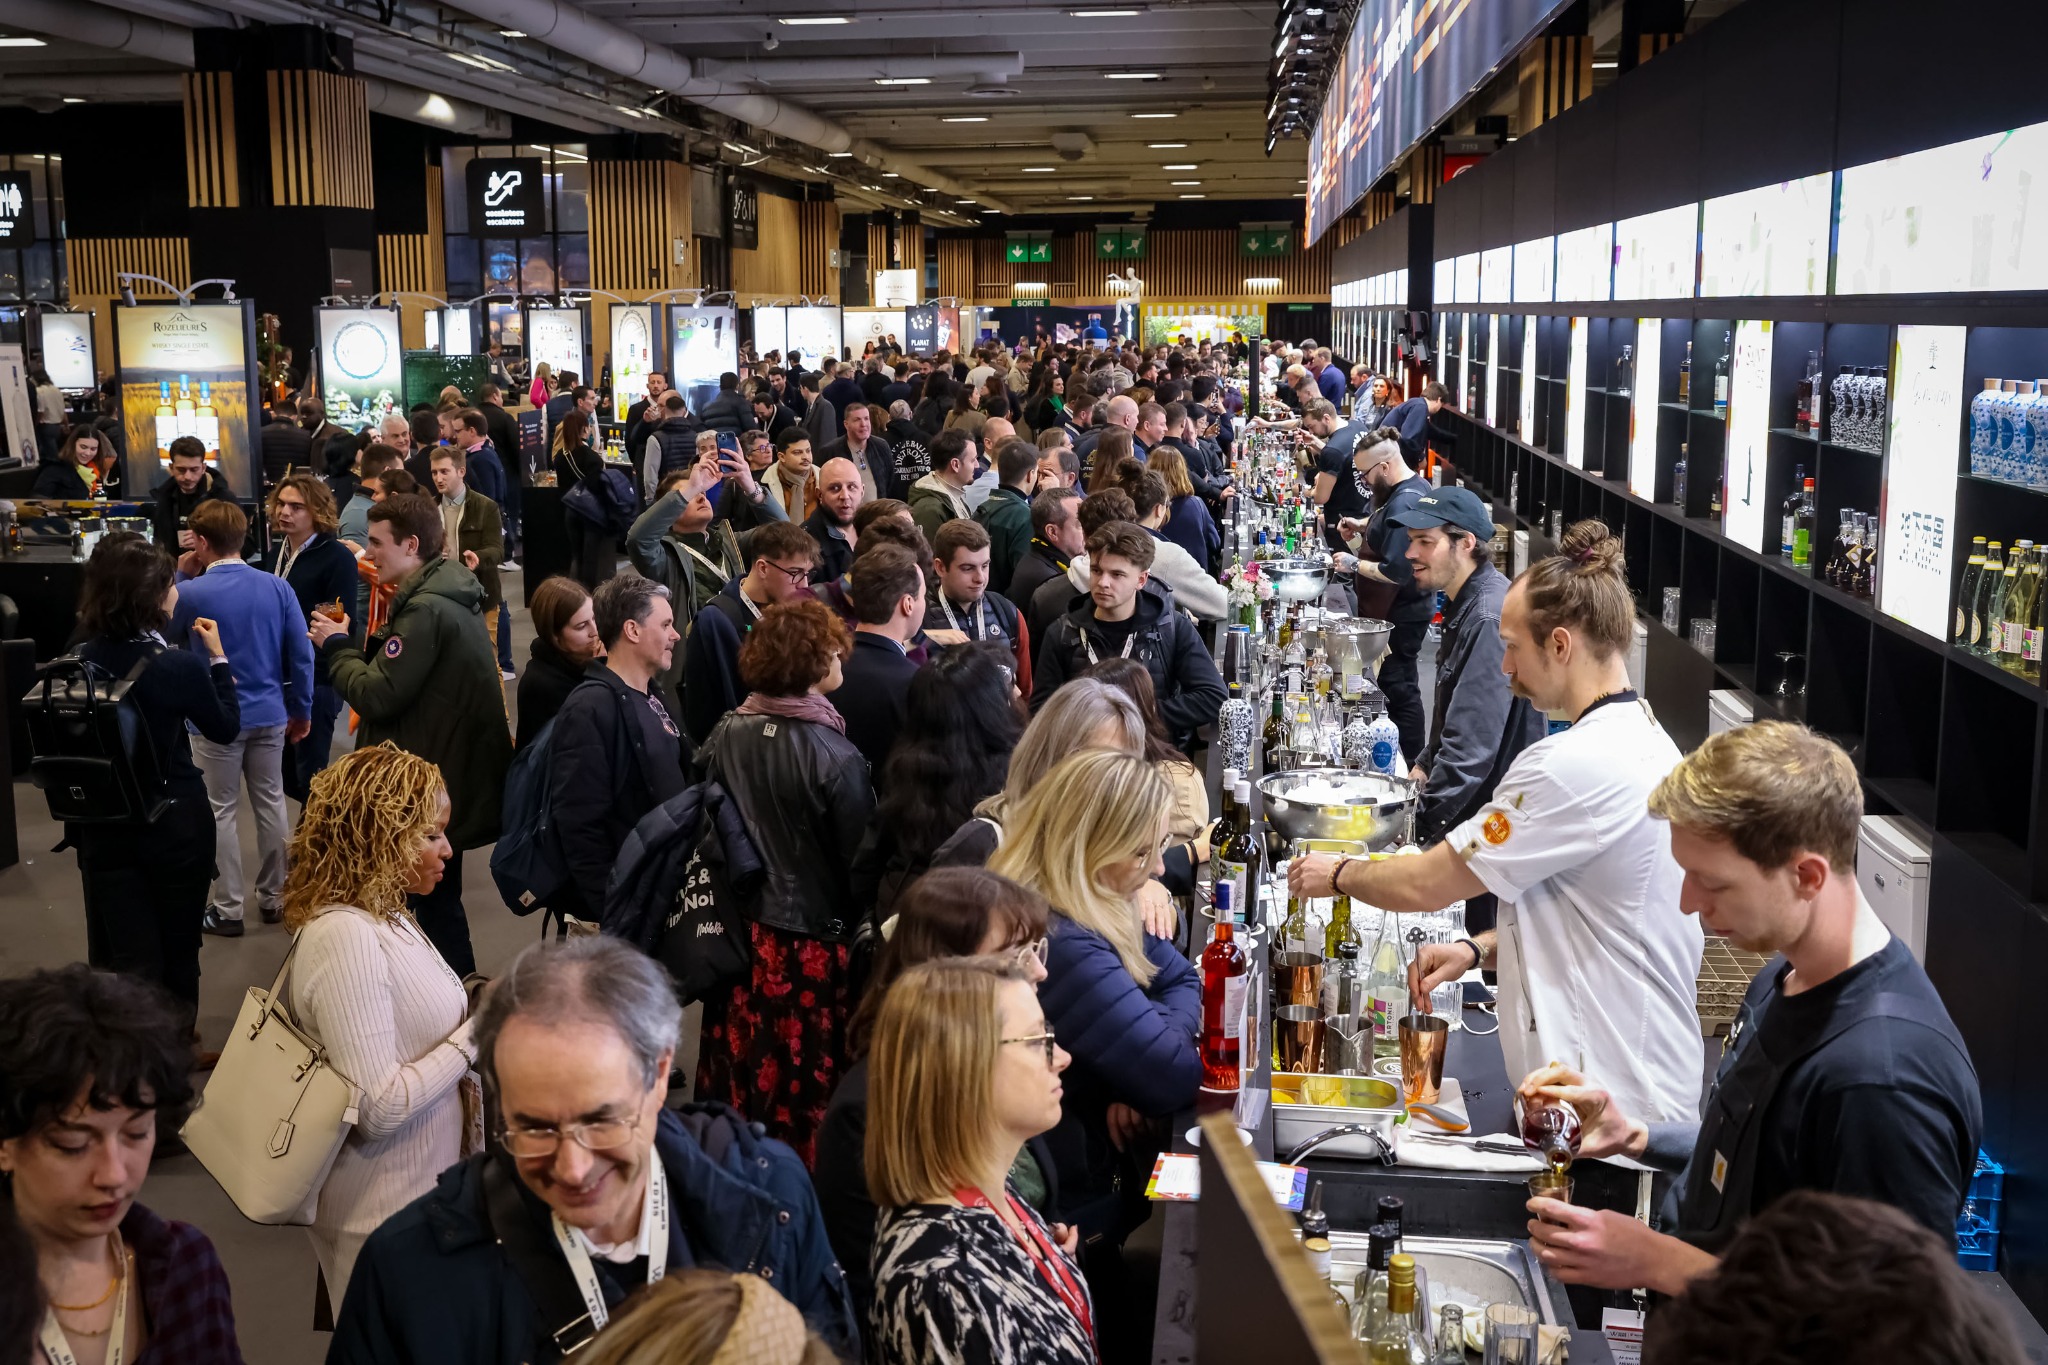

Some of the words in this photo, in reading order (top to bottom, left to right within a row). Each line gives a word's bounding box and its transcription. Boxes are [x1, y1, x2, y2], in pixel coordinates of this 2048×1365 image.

[486, 218, 525, 226] escalators
[895, 448, 923, 466] DETROIT
[698, 867, 711, 884] &
